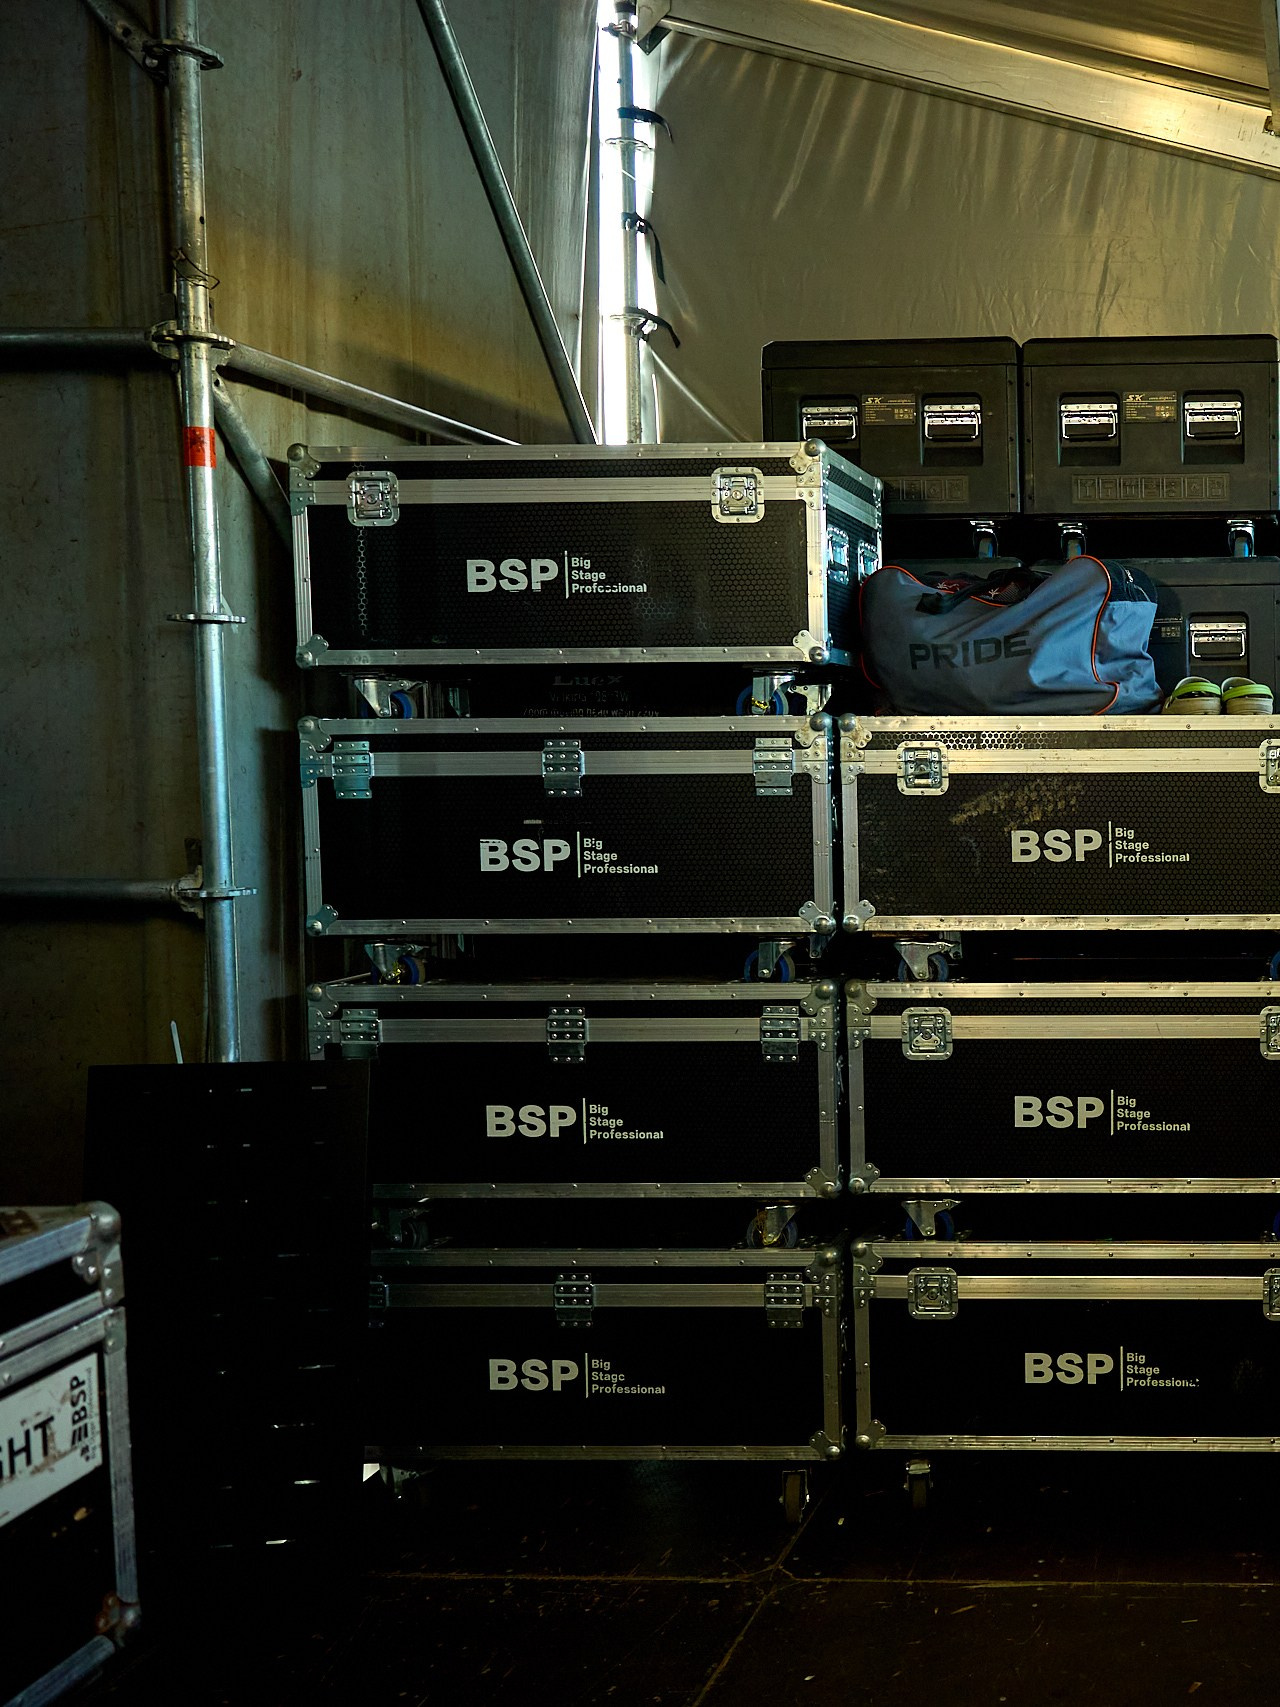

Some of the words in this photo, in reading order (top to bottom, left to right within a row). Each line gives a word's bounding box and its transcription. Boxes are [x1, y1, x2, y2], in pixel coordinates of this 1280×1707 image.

[571, 557, 591, 569] Big
[466, 558, 559, 593] BSP
[571, 570, 607, 582] Stage
[909, 630, 1033, 670] PRIDE
[1114, 827, 1135, 840] Big
[583, 837, 603, 850] Big
[1010, 828, 1103, 863] BSP
[1114, 839, 1150, 852] Stage
[479, 838, 571, 872] BSP
[583, 850, 618, 862] Stage
[1115, 852, 1190, 863] Professional
[583, 863, 659, 874] Professional
[1116, 1095, 1137, 1108] Big
[589, 1103, 609, 1117] Big
[1014, 1095, 1105, 1129] BSP
[1116, 1108, 1151, 1121] Stage
[485, 1104, 577, 1138] BSP
[589, 1116, 624, 1129] Stage
[1116, 1120, 1191, 1132] Professional
[589, 1129, 664, 1140] Professional
[591, 1359, 611, 1371] Big
[1126, 1352, 1146, 1365] Big
[488, 1358, 579, 1391] BSP
[1024, 1352, 1114, 1385] BSP
[1126, 1364, 1160, 1377] Stage
[591, 1383, 666, 1394] Professional
[71, 1376, 86, 1425] BSP
[0, 1415, 54, 1481] HT
